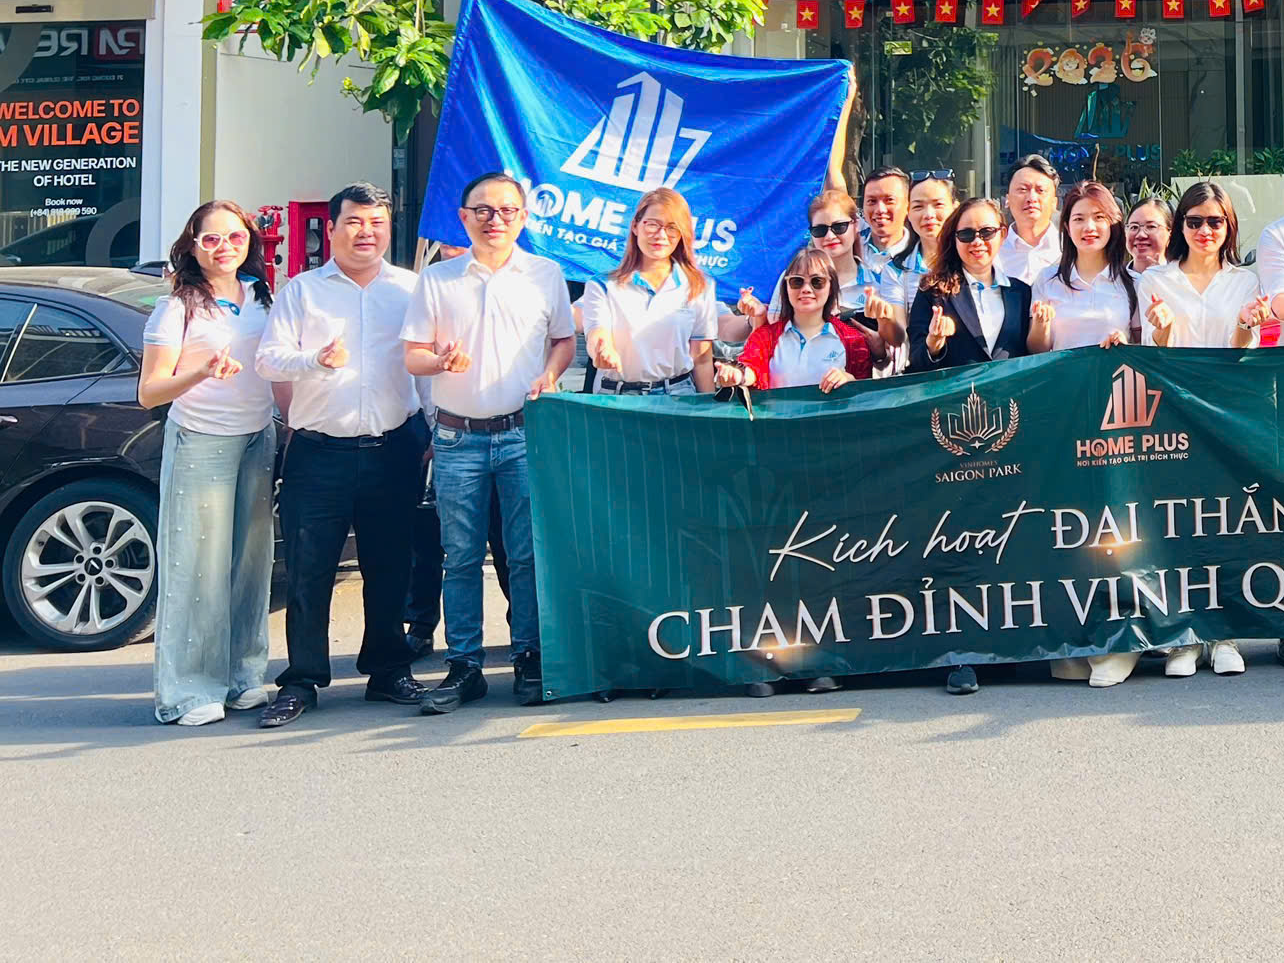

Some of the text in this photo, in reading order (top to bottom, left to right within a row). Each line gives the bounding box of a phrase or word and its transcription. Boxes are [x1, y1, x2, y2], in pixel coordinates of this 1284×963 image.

[1022, 34, 1156, 87] 2026
[0, 98, 140, 120] WELCOME TO
[23, 121, 140, 147] VILLAGE
[21, 159, 52, 171] NEW
[53, 157, 137, 170] GENERATION
[33, 174, 96, 187] OF HOTEL
[45, 198, 83, 206] Book now
[81, 206, 97, 215] 590
[557, 226, 588, 245] TẠO
[592, 236, 618, 253] GIÁ
[691, 216, 738, 253] US
[1076, 433, 1190, 458] HOME PLUS
[935, 463, 1022, 484] SAIGON PARK
[769, 510, 909, 582] Kích
[922, 500, 1045, 565] hoạt
[1050, 502, 1143, 556] ĐẠI
[648, 597, 851, 660] CHẠM
[866, 578, 1048, 641] ĐỈNH
[1058, 565, 1224, 626] VINH
